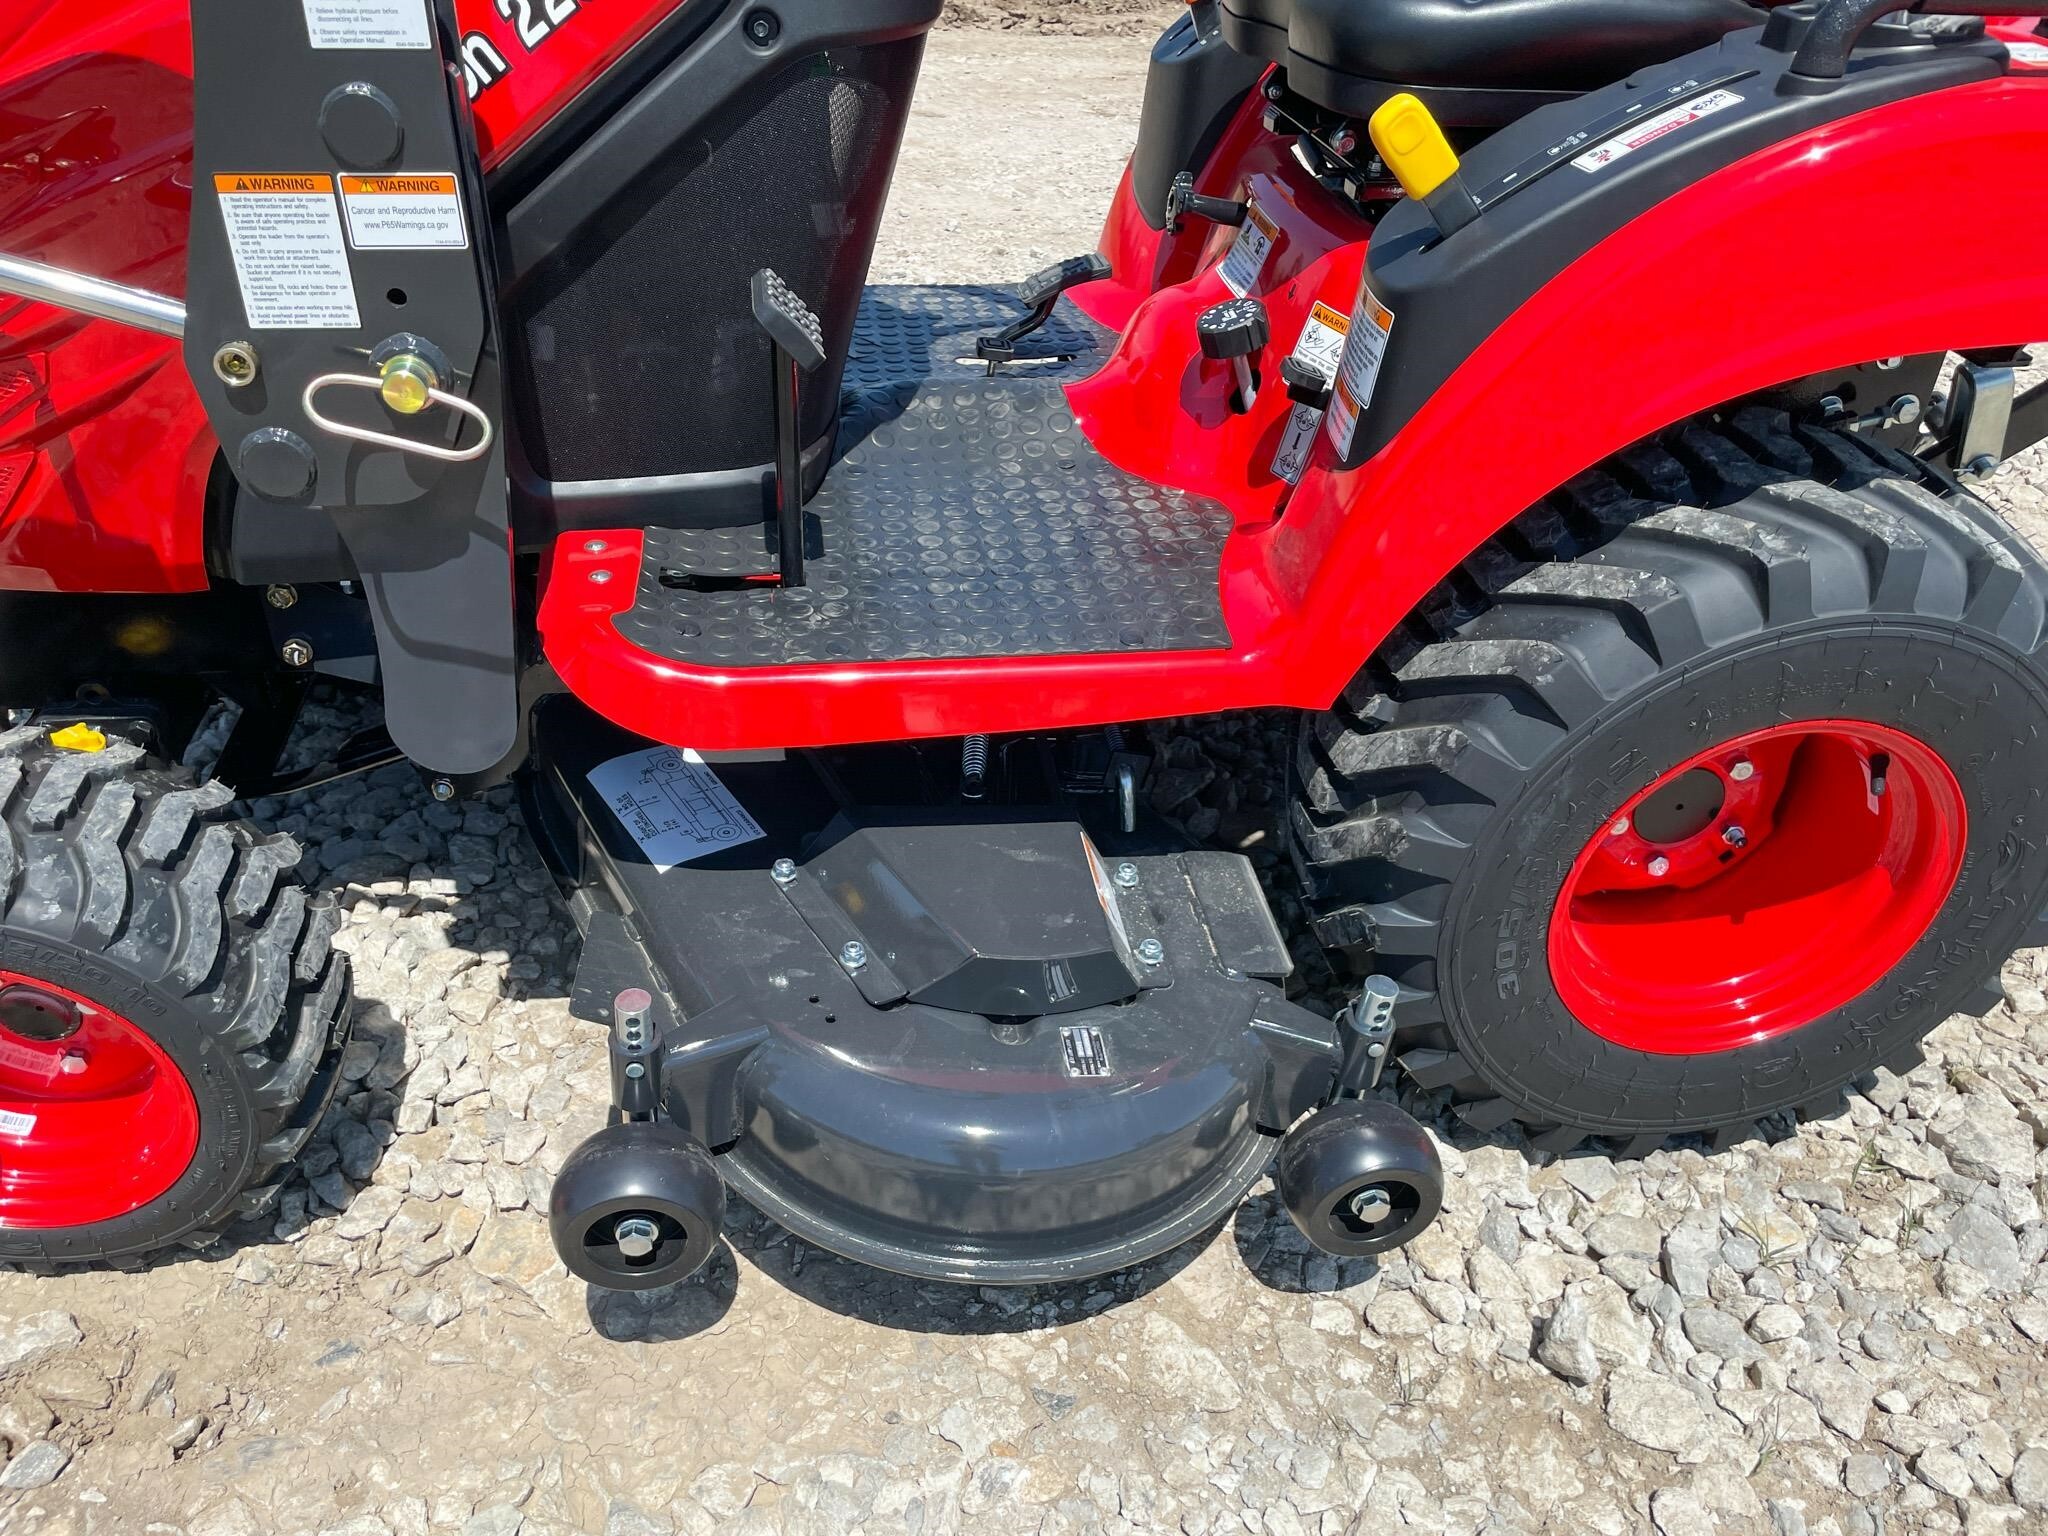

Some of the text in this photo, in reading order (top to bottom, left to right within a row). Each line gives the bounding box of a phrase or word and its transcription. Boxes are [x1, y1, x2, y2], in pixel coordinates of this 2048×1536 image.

[249, 178, 315, 190] WARNING
[376, 180, 440, 192] WARNING
[351, 206, 456, 216] Cancer and Reproductive Harm
[364, 221, 448, 230] www.P65Warnings.ca.gov
